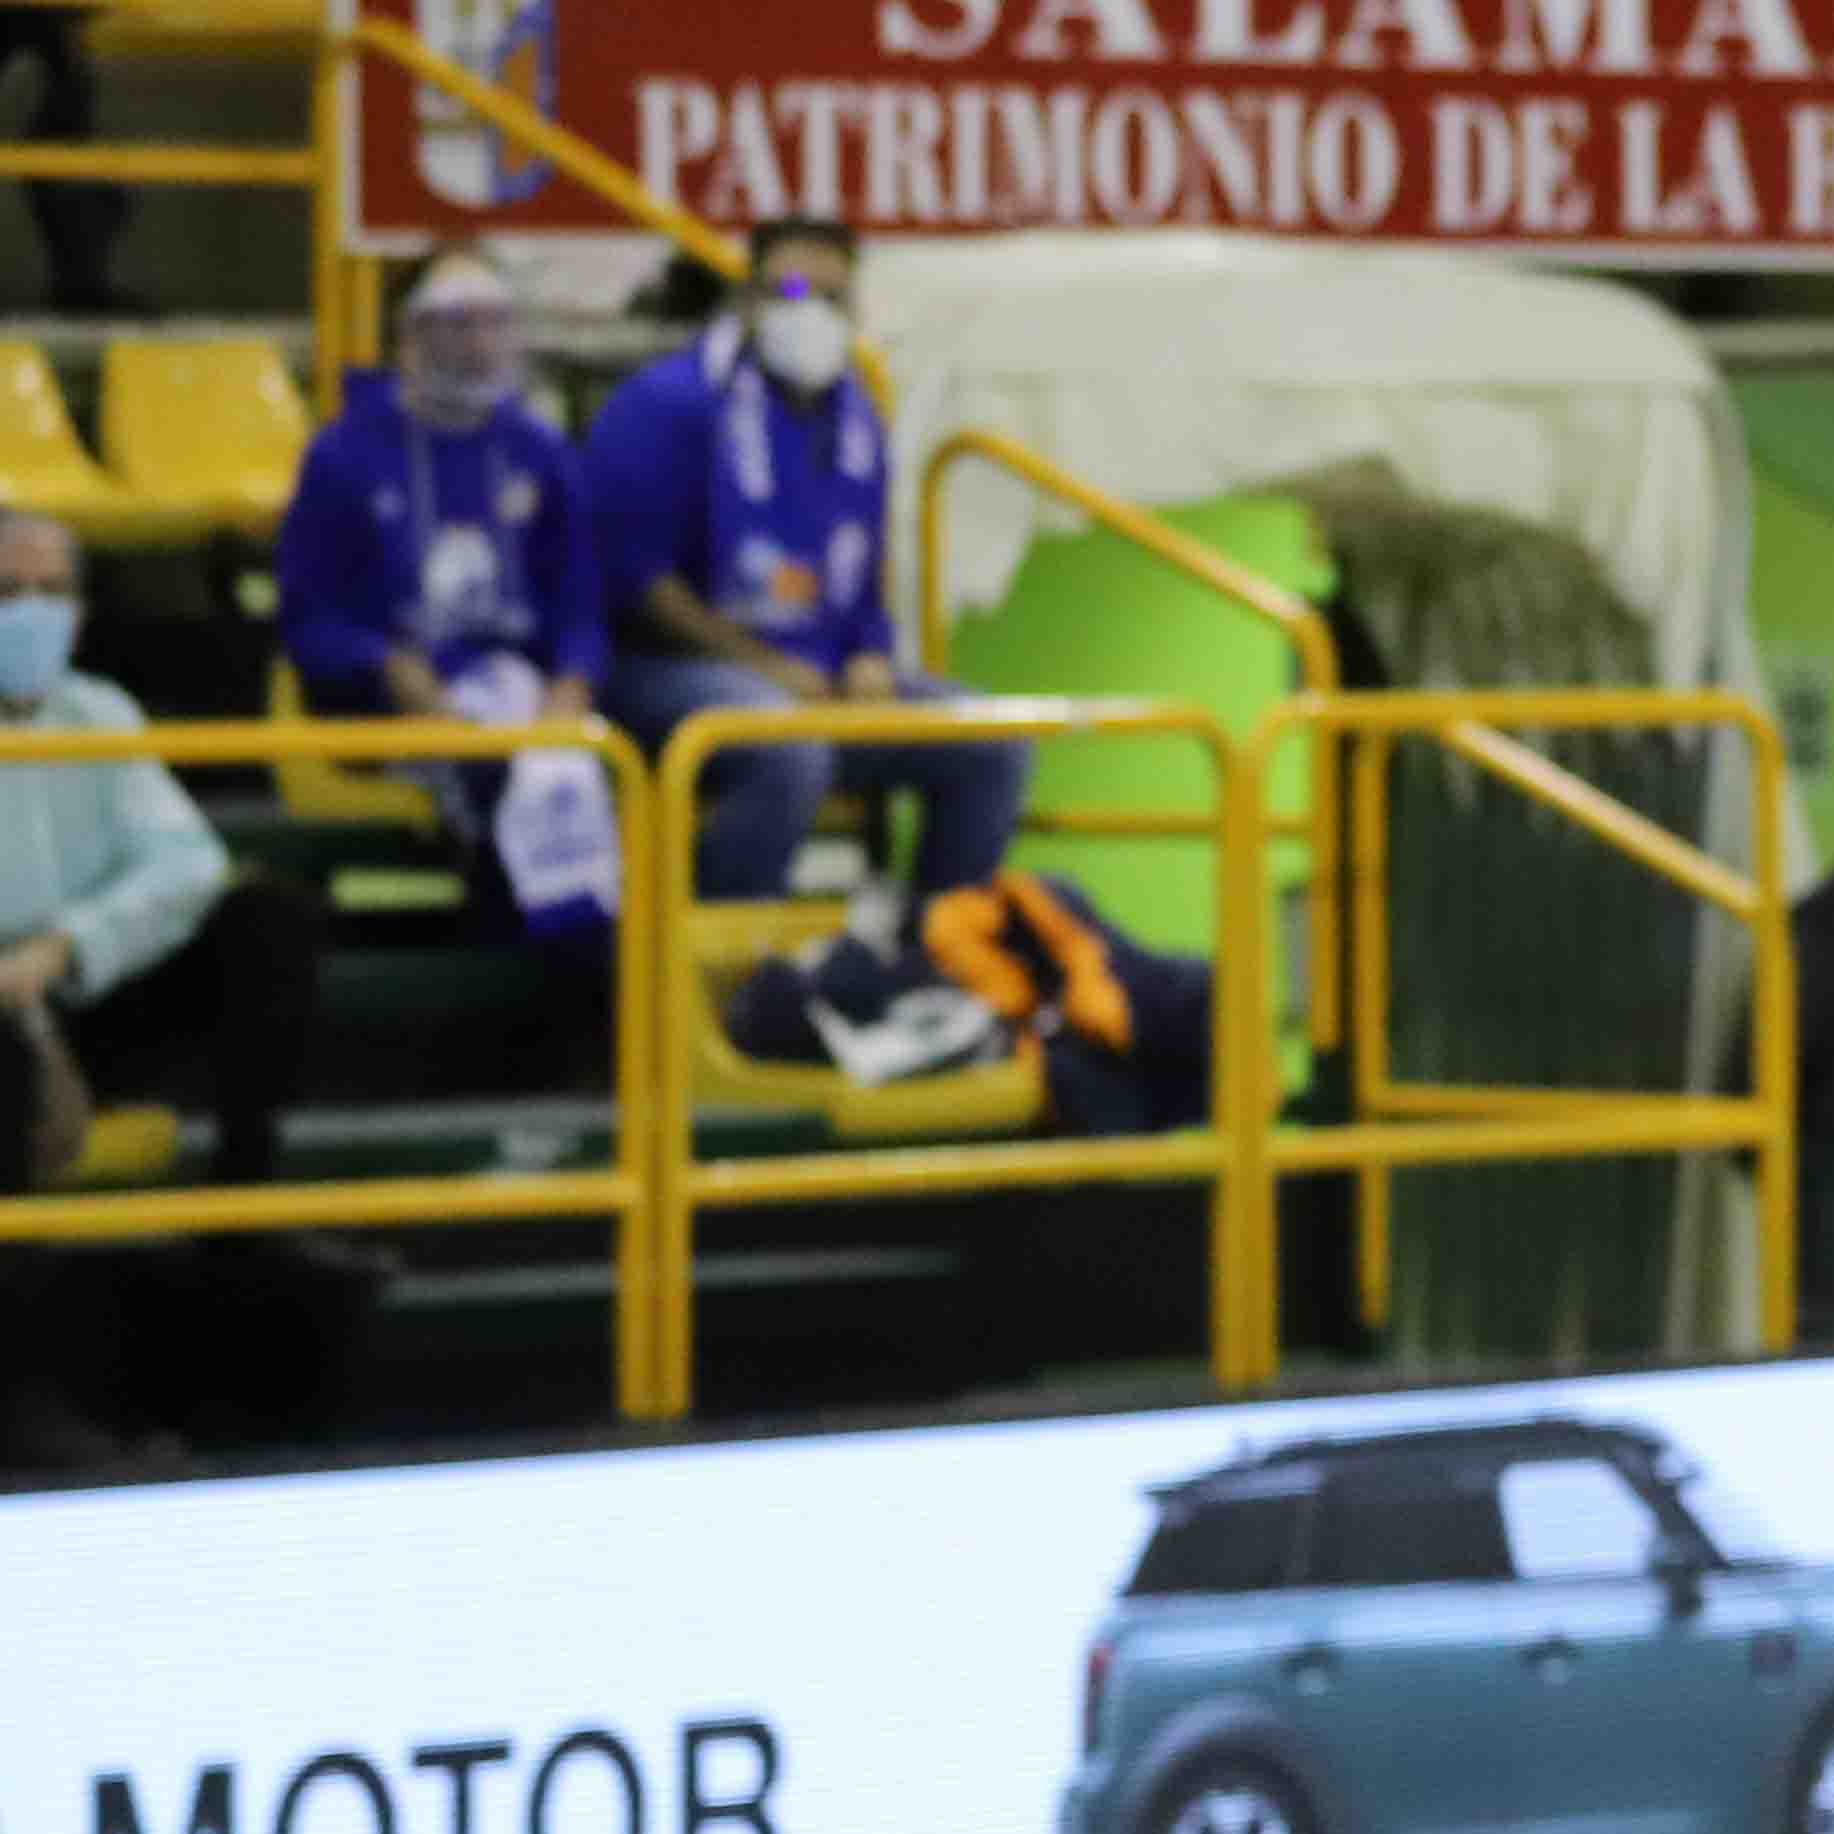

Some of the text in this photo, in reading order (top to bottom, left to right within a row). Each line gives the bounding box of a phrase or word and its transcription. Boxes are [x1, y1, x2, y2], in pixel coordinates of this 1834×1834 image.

[634, 76, 1402, 228] PATRIMONIO
[1428, 92, 1594, 234] DE
[1618, 98, 1760, 236] LA
